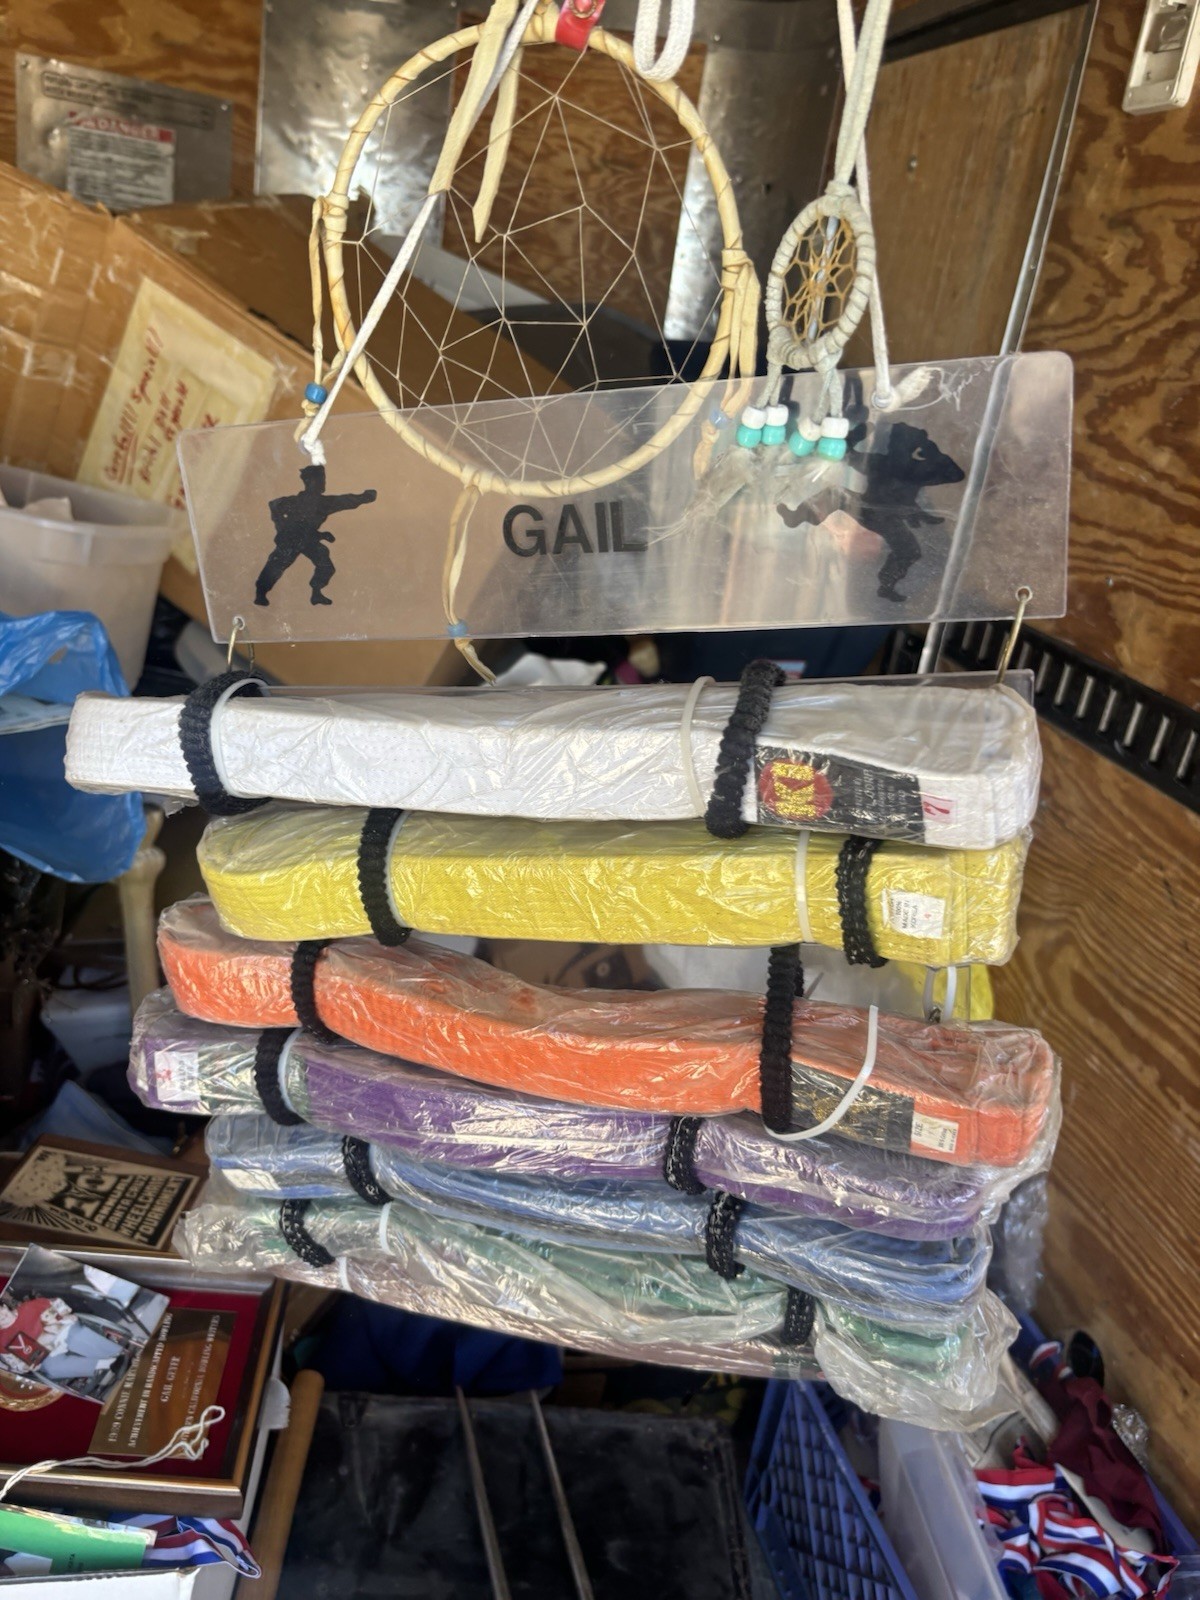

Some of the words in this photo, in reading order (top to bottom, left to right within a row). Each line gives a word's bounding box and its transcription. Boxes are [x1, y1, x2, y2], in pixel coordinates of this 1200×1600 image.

[503, 501, 649, 558] GAIL
[770, 761, 818, 819] KI
[94, 1174, 134, 1224] ANNUAL
[104, 1199, 134, 1231] SANTA
[124, 1174, 151, 1199] CRUZ
[118, 1174, 165, 1238] WHEELCHAIR
[133, 1174, 188, 1242] TOURNAMENT
[158, 1313, 173, 1341] BOWLING
[144, 1342, 165, 1388] HANDICAPPED
[187, 1374, 205, 1414] CALIFORNIA
[198, 1343, 213, 1373] BOWLING
[141, 1388, 152, 1399] IN
[160, 1383, 173, 1402] GAIL
[128, 1399, 148, 1448] ACHIEVEMENT
